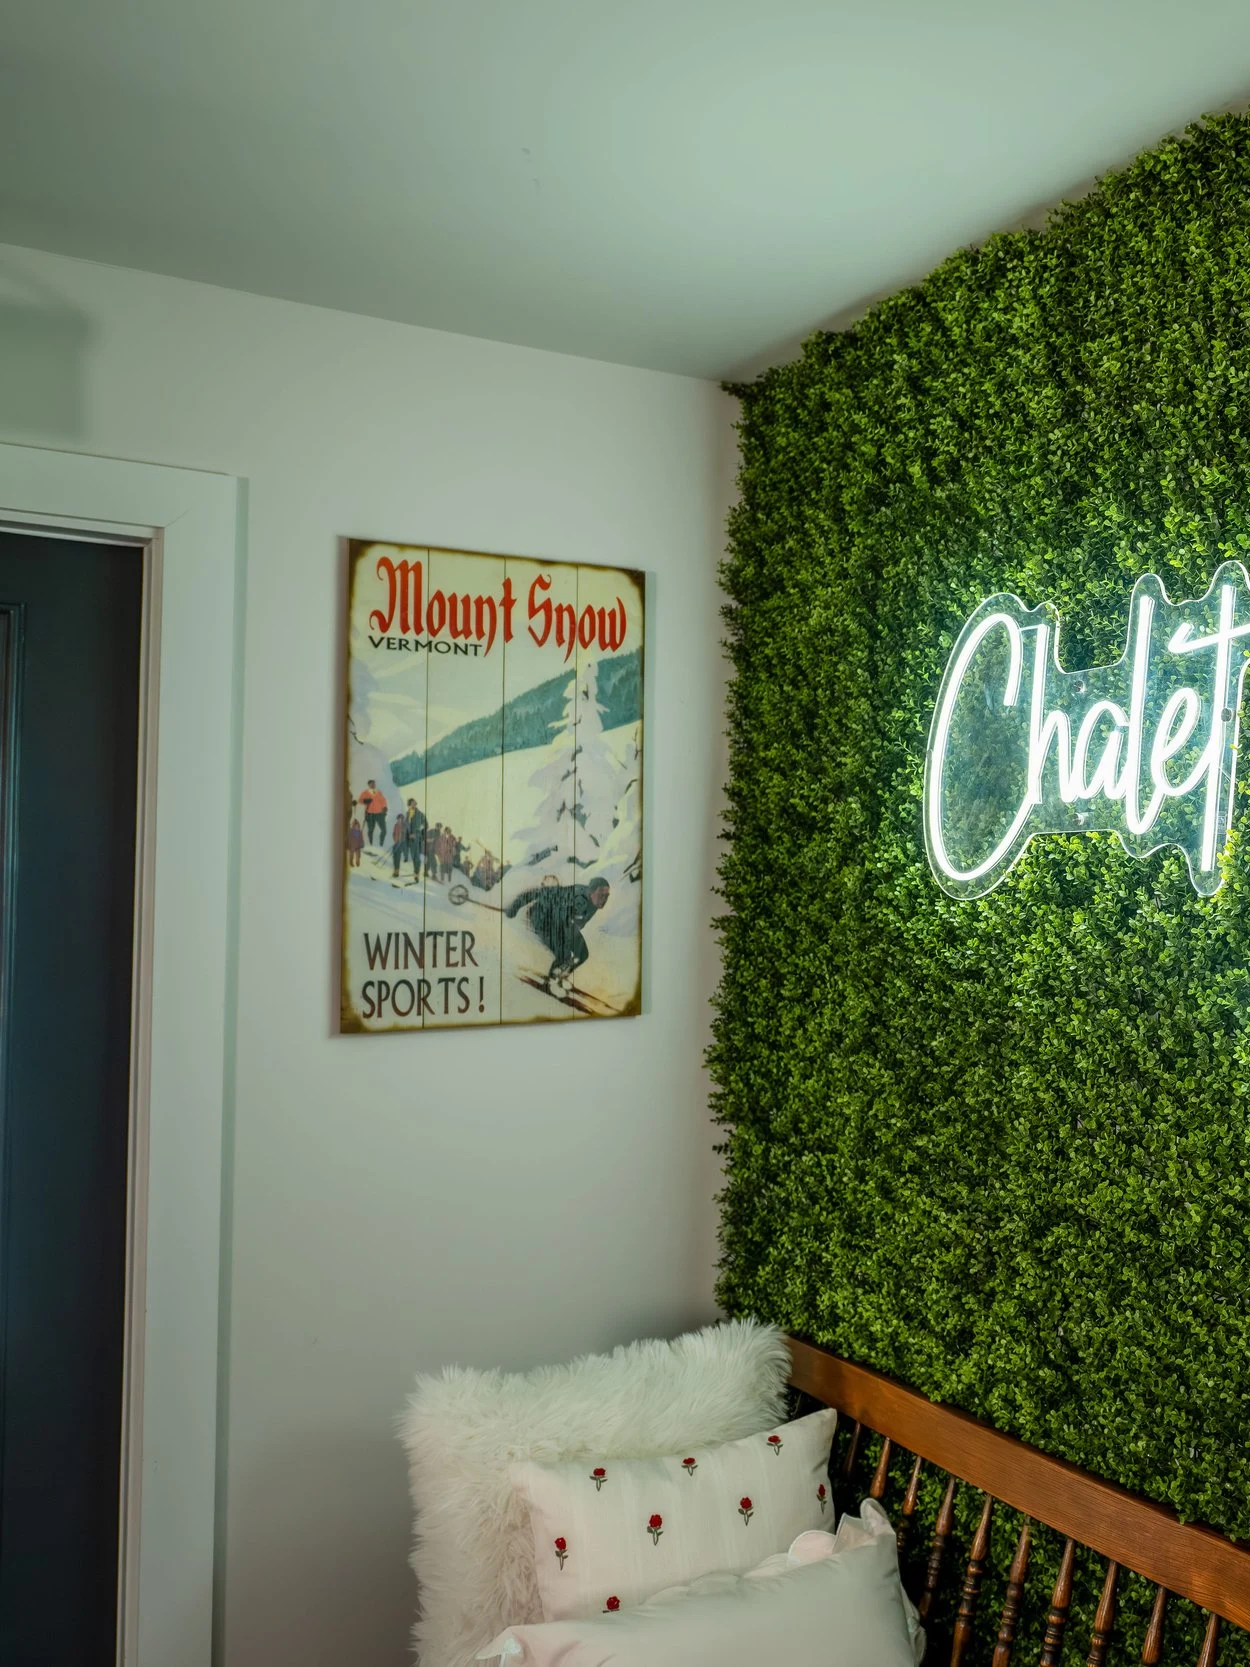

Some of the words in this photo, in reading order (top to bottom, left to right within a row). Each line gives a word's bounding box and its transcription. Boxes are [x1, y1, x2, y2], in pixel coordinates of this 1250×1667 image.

[369, 556, 517, 658] Mount
[528, 574, 627, 664] Snow
[368, 635, 485, 657] VERMONT
[363, 930, 479, 970] WINTER
[361, 975, 485, 1019] SPORTS!
